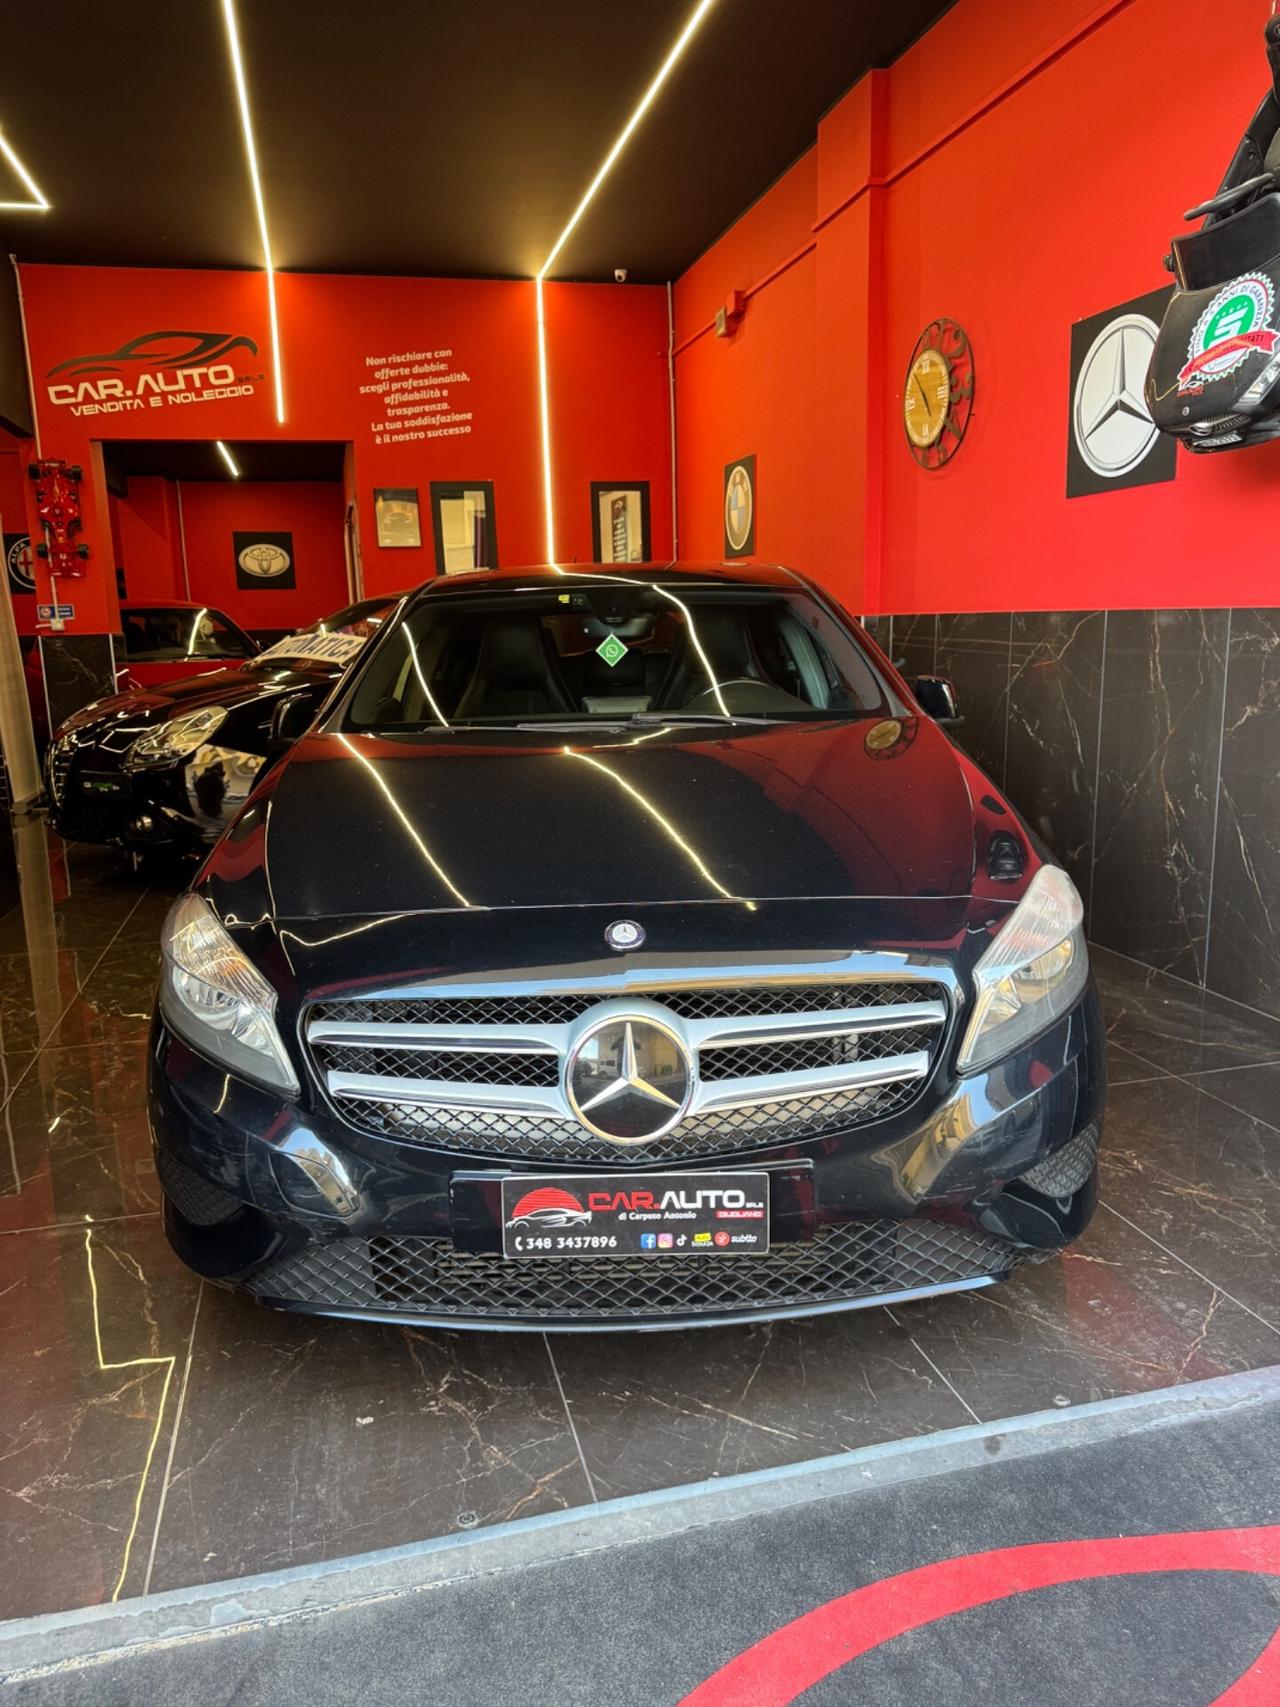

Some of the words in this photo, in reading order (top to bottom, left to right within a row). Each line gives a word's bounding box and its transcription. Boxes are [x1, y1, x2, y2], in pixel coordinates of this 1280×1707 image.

[1240, 284, 1250, 293] DI
[366, 356, 386, 367] Non
[388, 351, 432, 364] rischiare
[434, 349, 452, 359] con
[374, 366, 411, 380] offerte
[412, 362, 449, 375] dubbie:
[48, 364, 235, 405] CAR.AUTO
[359, 381, 390, 394] scegli
[391, 371, 471, 392] professionalità,
[70, 398, 145, 417] VENDITA
[150, 396, 163, 407] E
[168, 384, 254, 405] NOLEGGIO
[384, 388, 440, 405] affidabilità
[442, 389, 449, 397] e
[387, 402, 450, 417] trasparenza.
[371, 422, 384, 432] La
[385, 421, 402, 431] tua
[403, 411, 473, 429] soddisfazione
[375, 435, 382, 445] è
[383, 434, 391, 444] il
[392, 431, 426, 442] nostro
[427, 425, 472, 438] successo
[10, 542, 27, 564] ALFA
[587, 1189, 746, 1211] CAR.AUTO
[618, 1212, 627, 1221] di
[663, 1210, 697, 1220] Antonio
[526, 1237, 553, 1250] 348
[556, 1236, 618, 1249] 3437896
